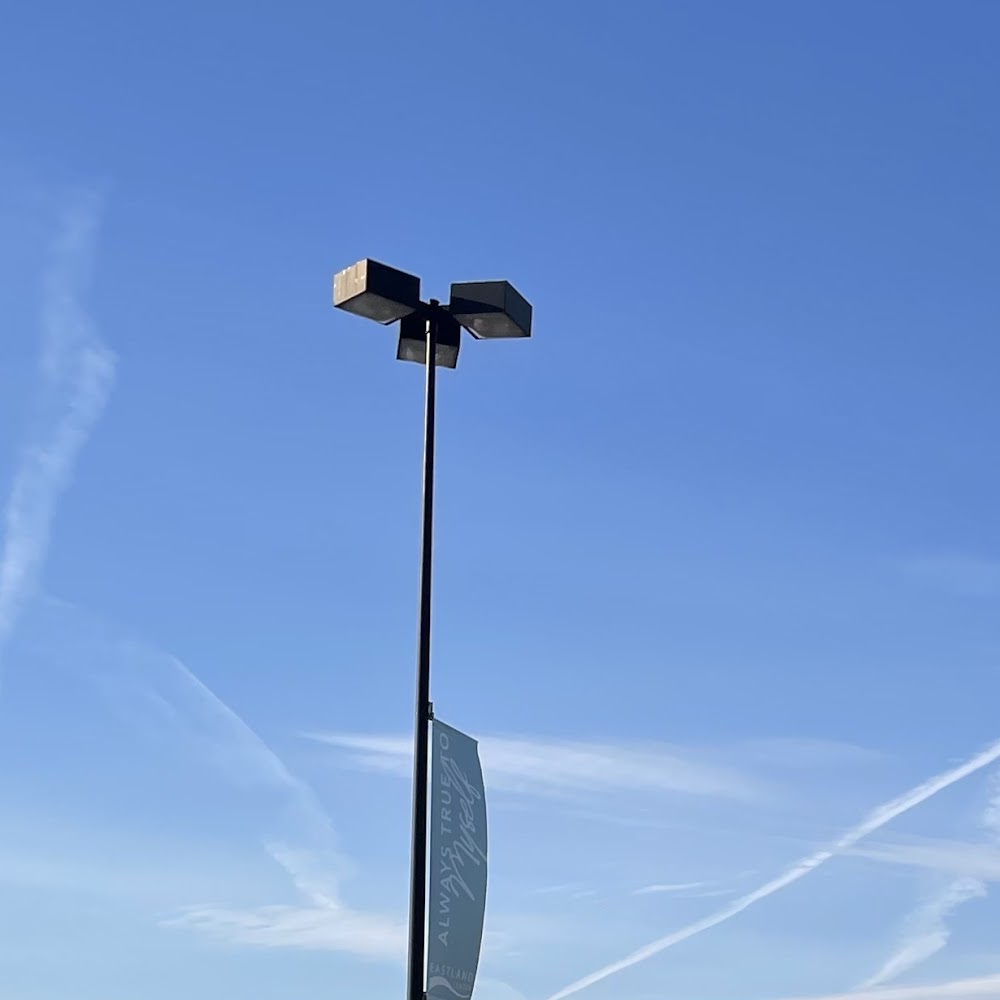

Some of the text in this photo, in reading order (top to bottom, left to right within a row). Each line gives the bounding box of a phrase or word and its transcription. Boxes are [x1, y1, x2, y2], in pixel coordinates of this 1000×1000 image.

[438, 732, 452, 947] ALWAYS TRUE TO
[447, 759, 487, 901] Myself
[430, 962, 474, 983] EASTLAND
